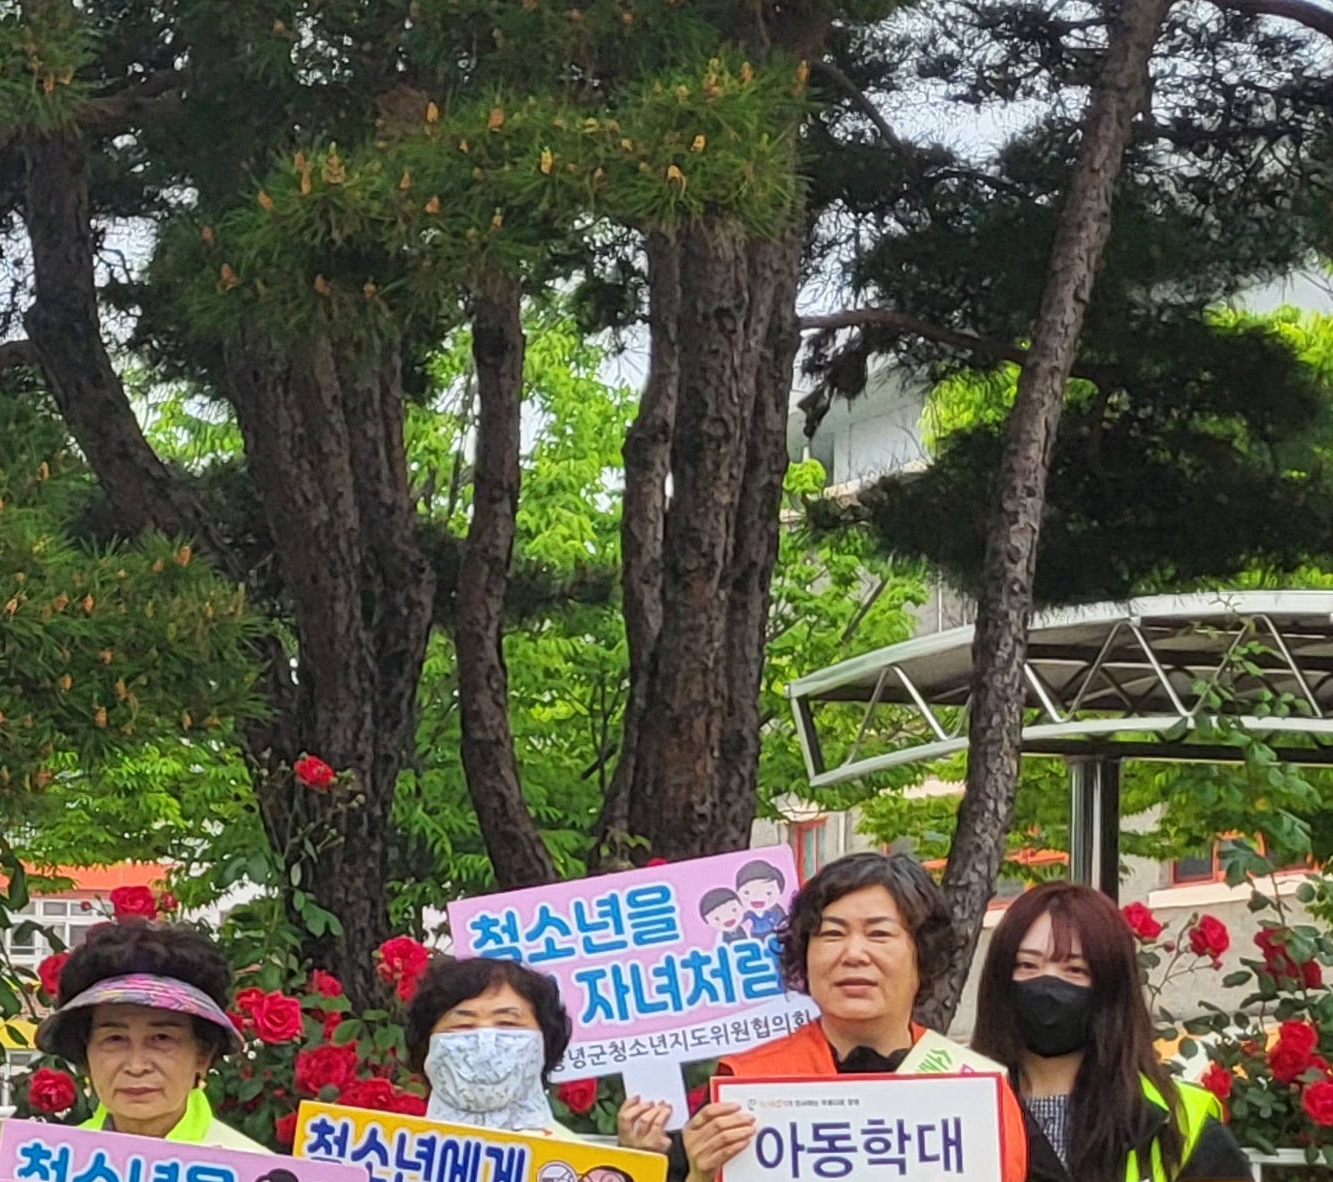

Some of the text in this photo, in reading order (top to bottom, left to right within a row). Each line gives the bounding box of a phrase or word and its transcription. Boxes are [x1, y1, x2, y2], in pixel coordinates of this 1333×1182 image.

[470, 884, 680, 963] 청소년을
[575, 938, 790, 1024] 자녀처럼
[755, 1116, 964, 1179] 아동학대
